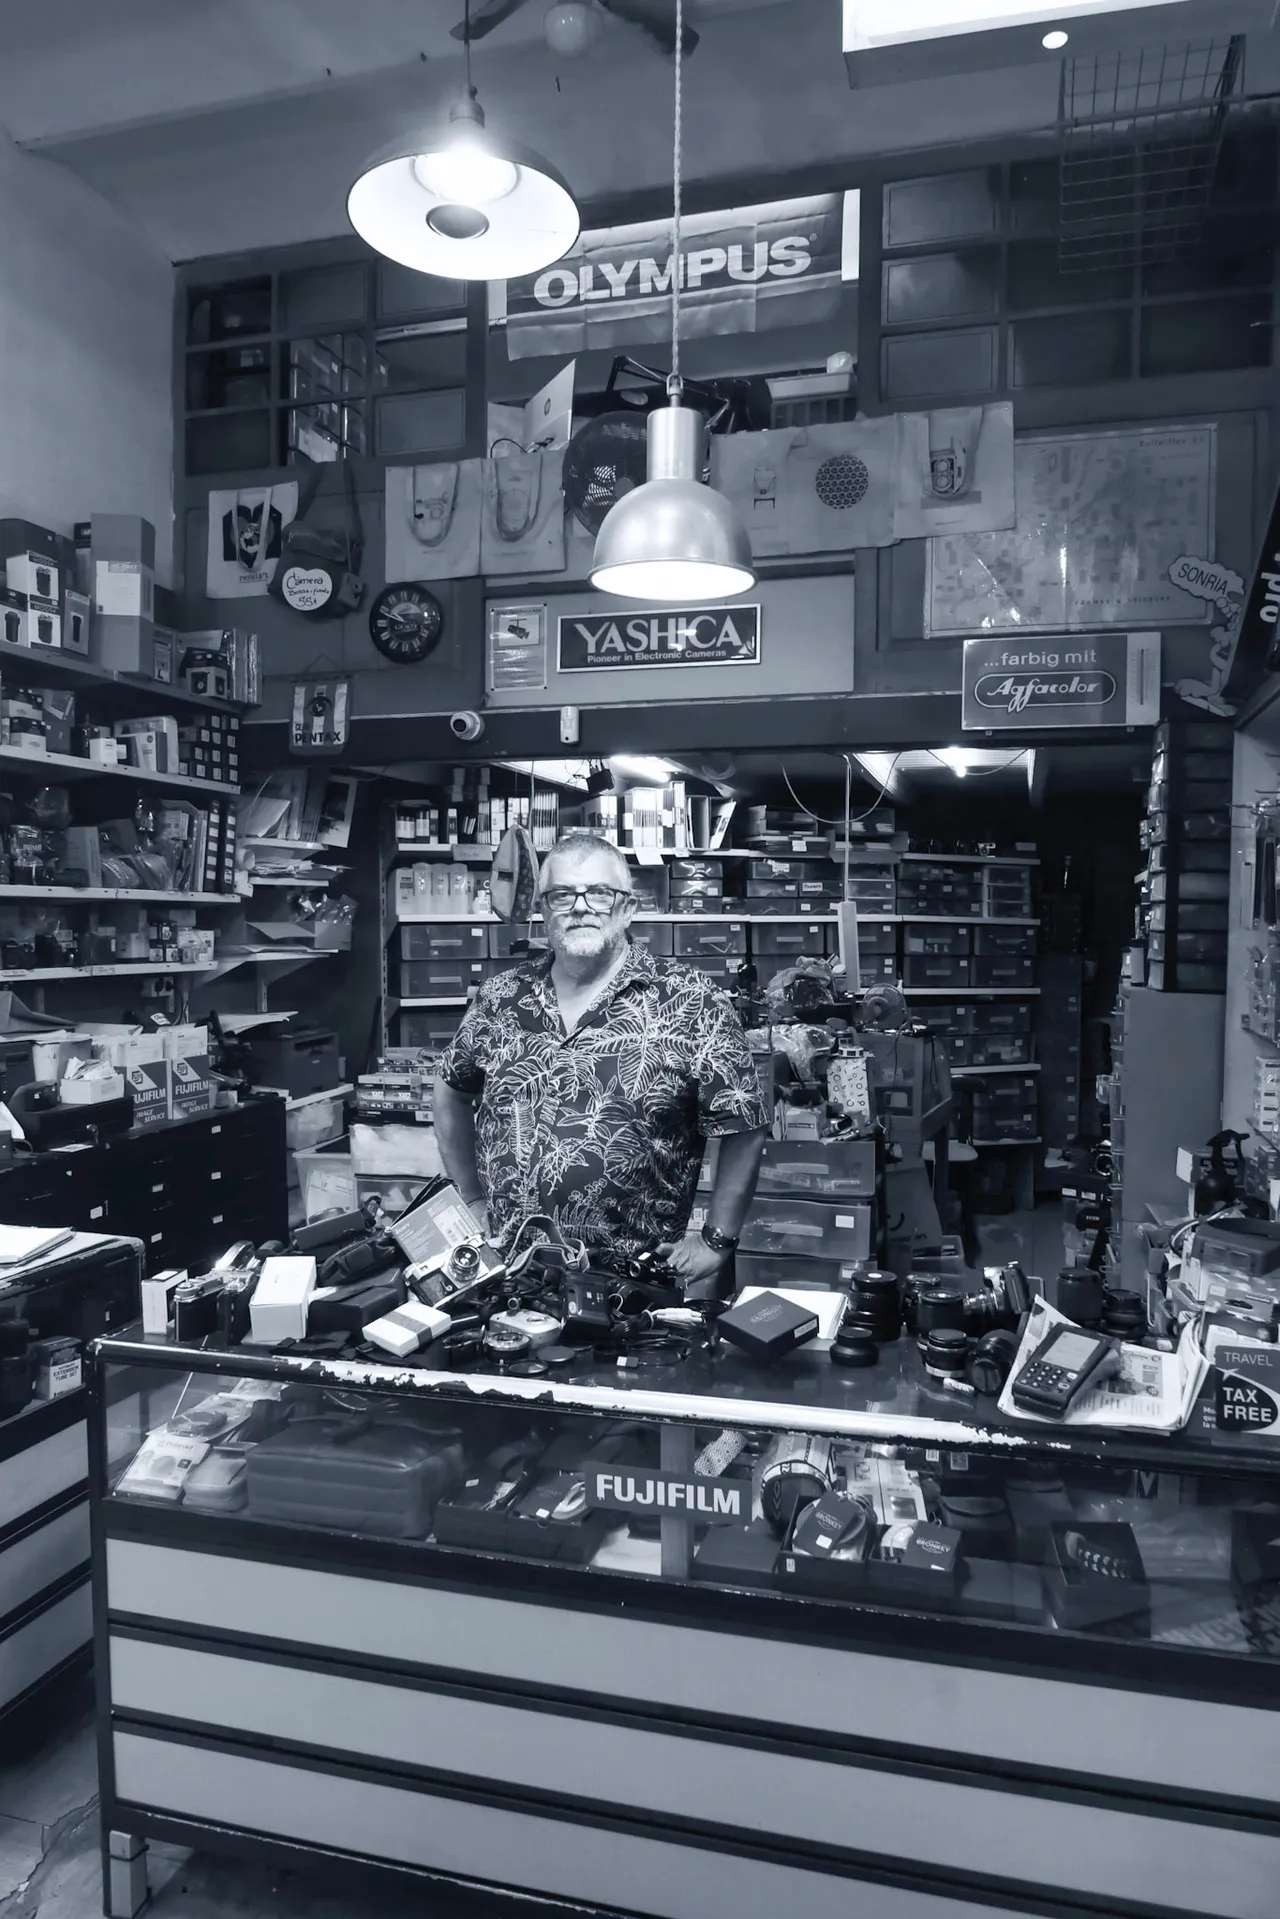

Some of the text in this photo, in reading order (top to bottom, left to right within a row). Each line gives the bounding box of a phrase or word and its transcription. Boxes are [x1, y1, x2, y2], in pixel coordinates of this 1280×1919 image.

[533, 235, 811, 307] OLYMPUS
[1178, 563, 1227, 595] SONRIA
[574, 614, 742, 653] YASHICA
[587, 649, 727, 663] Pioneer in Electronic Cameras
[1065, 649, 1097, 663] mit
[987, 676, 1100, 713] Agfacolor
[295, 732, 341, 743] PENTAX
[175, 1080, 209, 1095] FUJIFILM
[137, 1108, 154, 1118] IMAGE
[144, 1112, 165, 1123] SERVICE
[1224, 1351, 1273, 1366] TRAVEL
[1222, 1387, 1258, 1404] TAX
[1223, 1404, 1272, 1422] FREE
[597, 1473, 740, 1515] FUJIFILM
[916, 1539, 951, 1552] BRONKEY
